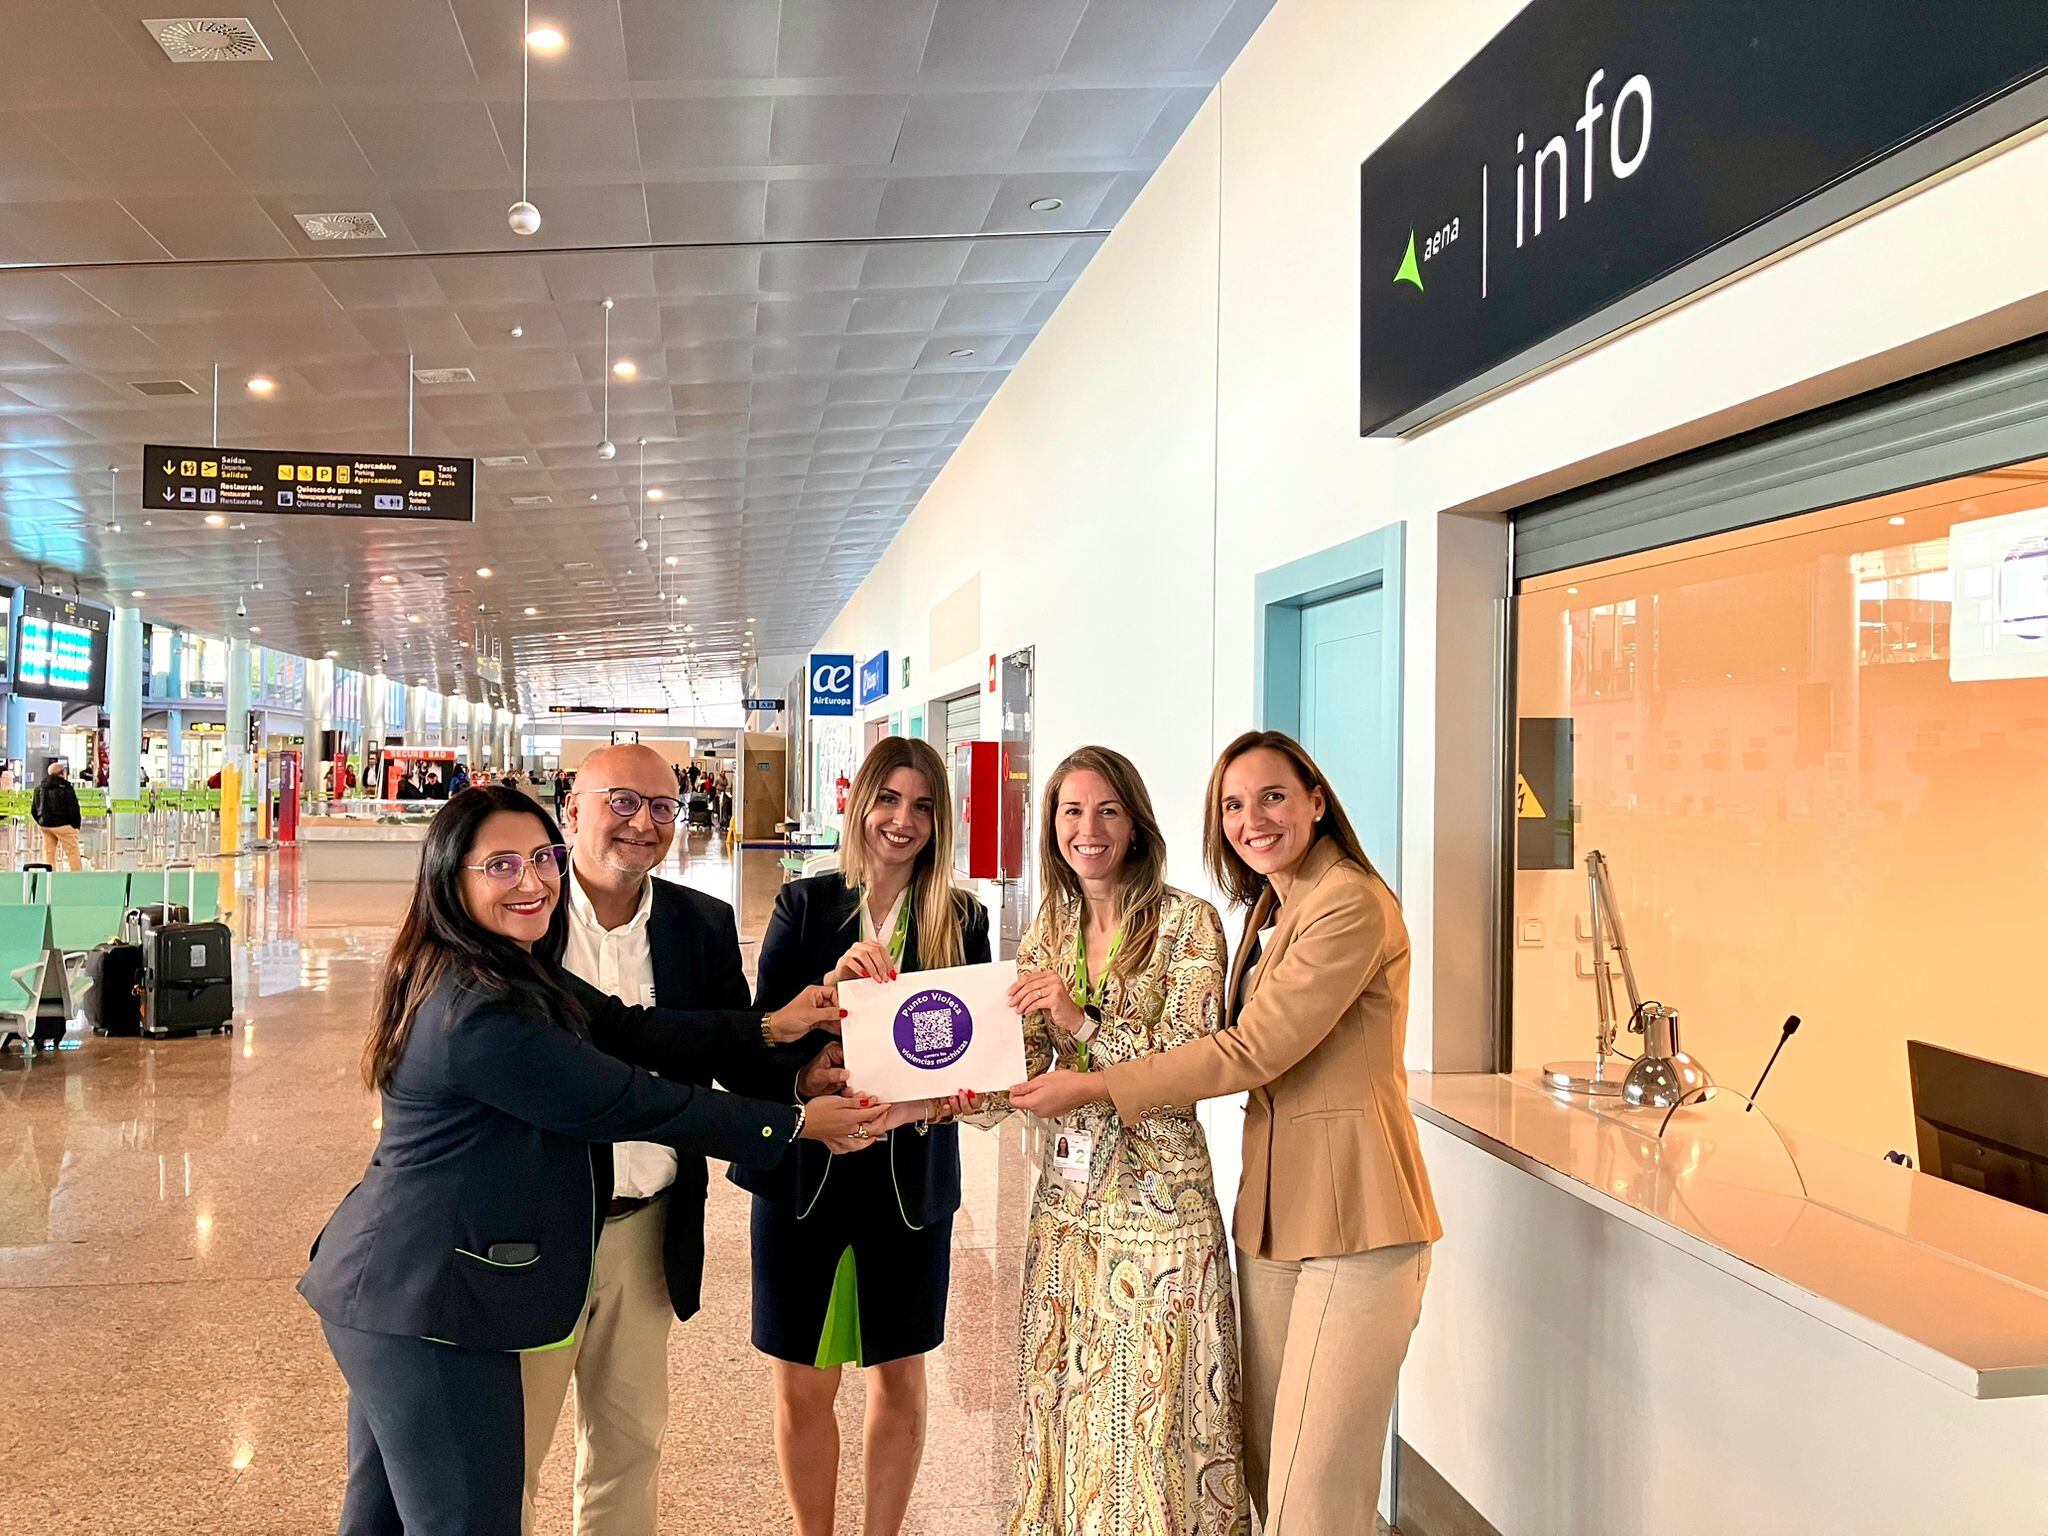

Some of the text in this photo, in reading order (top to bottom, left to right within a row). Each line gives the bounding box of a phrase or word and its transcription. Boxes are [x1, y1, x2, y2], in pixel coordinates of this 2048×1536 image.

[1516, 68, 1652, 248] info
[1424, 216, 1459, 262] aena
[901, 992, 962, 1017] Punto Violeta
[901, 1040, 968, 1066] violencias machistas
[1075, 1149, 1086, 1164] 2
